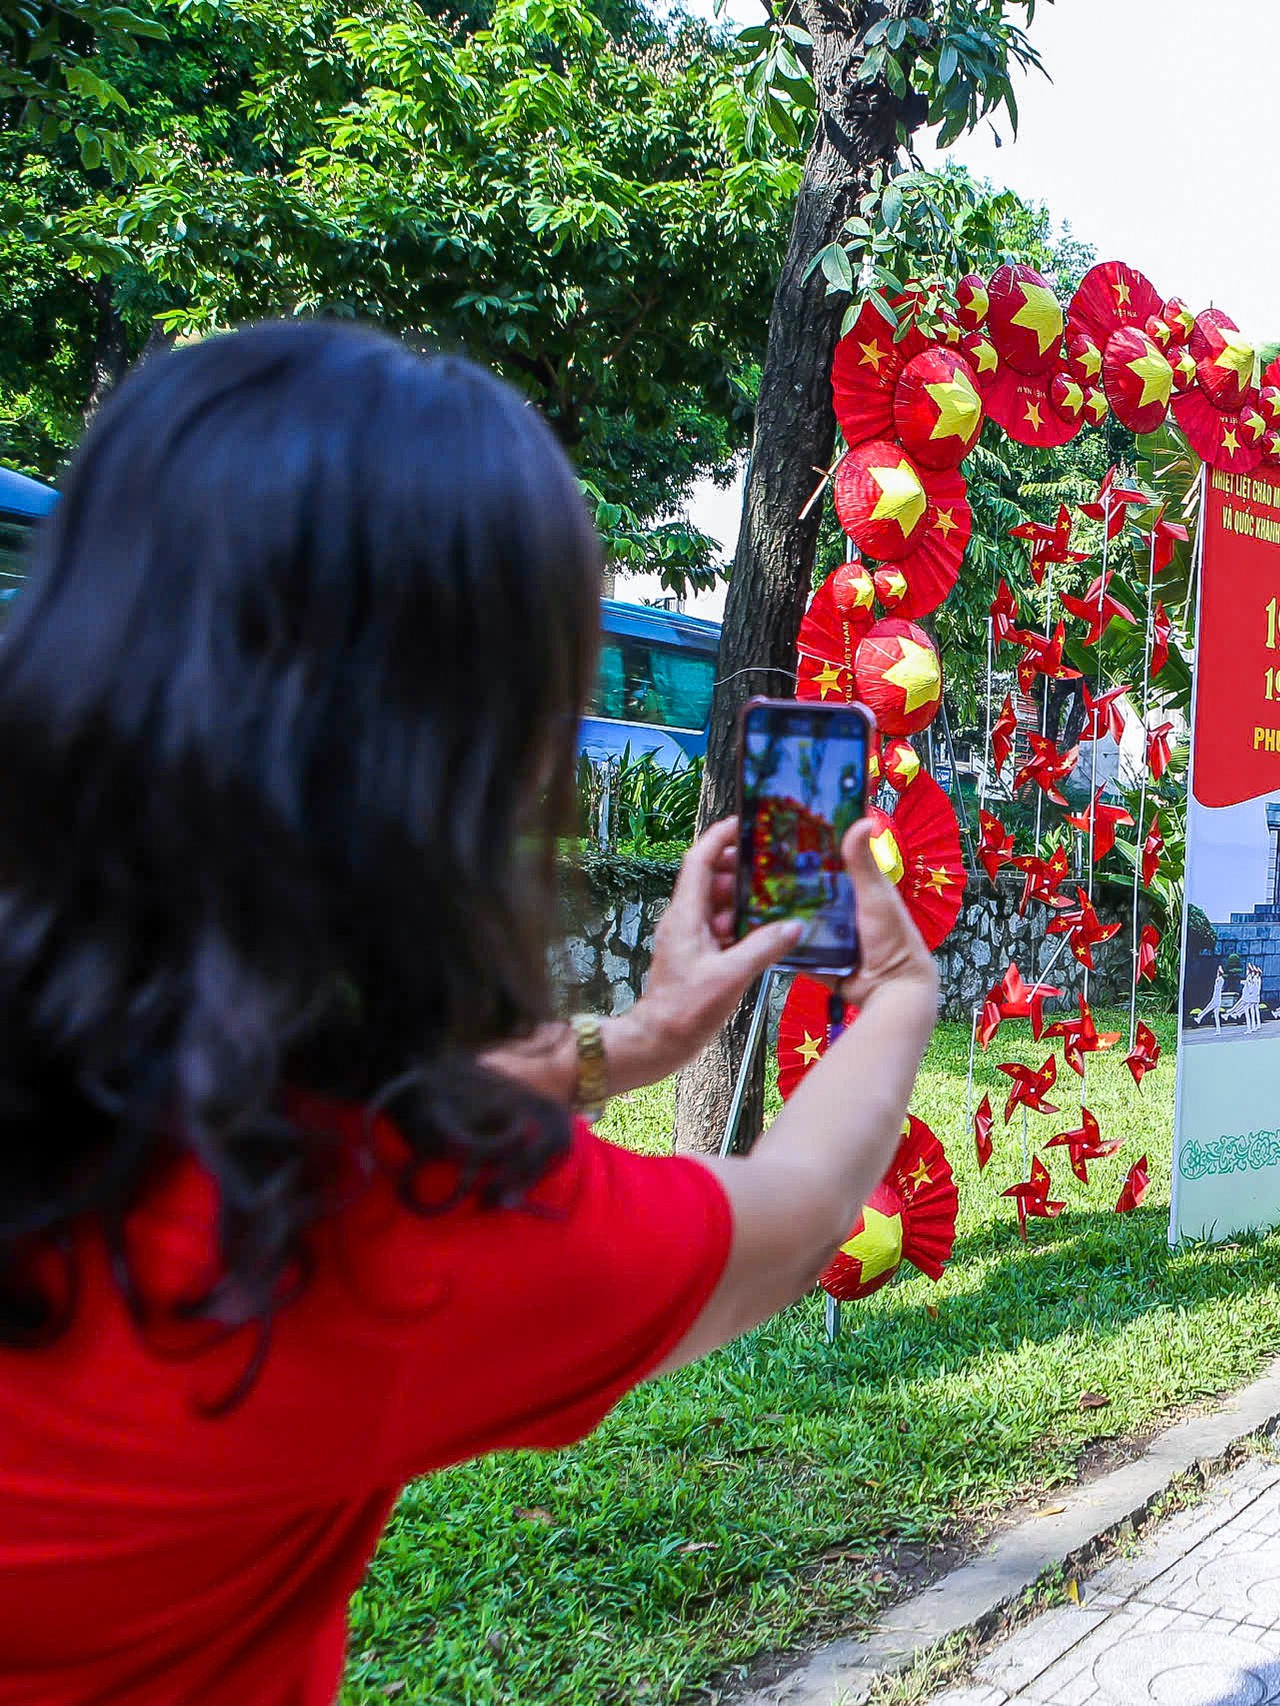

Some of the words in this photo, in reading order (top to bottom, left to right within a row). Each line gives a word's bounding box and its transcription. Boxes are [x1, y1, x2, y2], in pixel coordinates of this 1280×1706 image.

[1252, 479, 1272, 506] CHÀO
[1222, 504, 1232, 530] VÀ
[1234, 506, 1254, 537] QUỐC
[1255, 515, 1280, 545] KHÁNH
